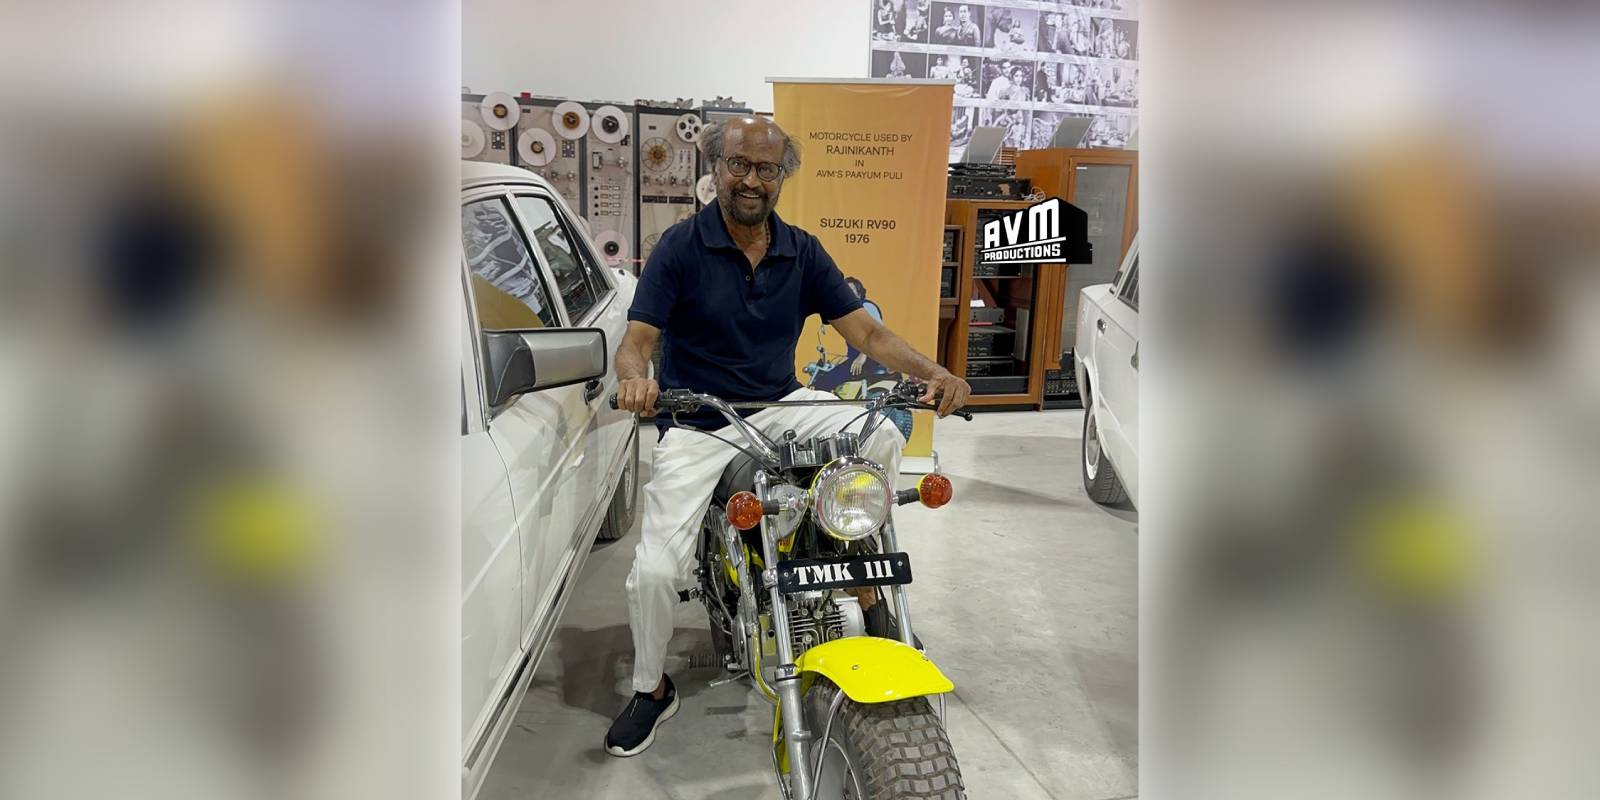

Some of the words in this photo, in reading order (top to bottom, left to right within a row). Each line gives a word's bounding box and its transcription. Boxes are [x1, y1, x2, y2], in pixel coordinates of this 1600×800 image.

[809, 132, 871, 141] MOTORCYCLE
[873, 133, 898, 142] USED
[900, 134, 913, 143] BY
[826, 145, 894, 156] RAJINIKANTH
[816, 170, 843, 179] AVM'S
[845, 171, 881, 180] PAAYUM
[883, 172, 903, 180] PULI
[820, 218, 864, 229] SUZUKI
[866, 219, 896, 230] RV90
[845, 234, 870, 244] 1976
[793, 562, 853, 585] TMK
[864, 559, 894, 579] 111
